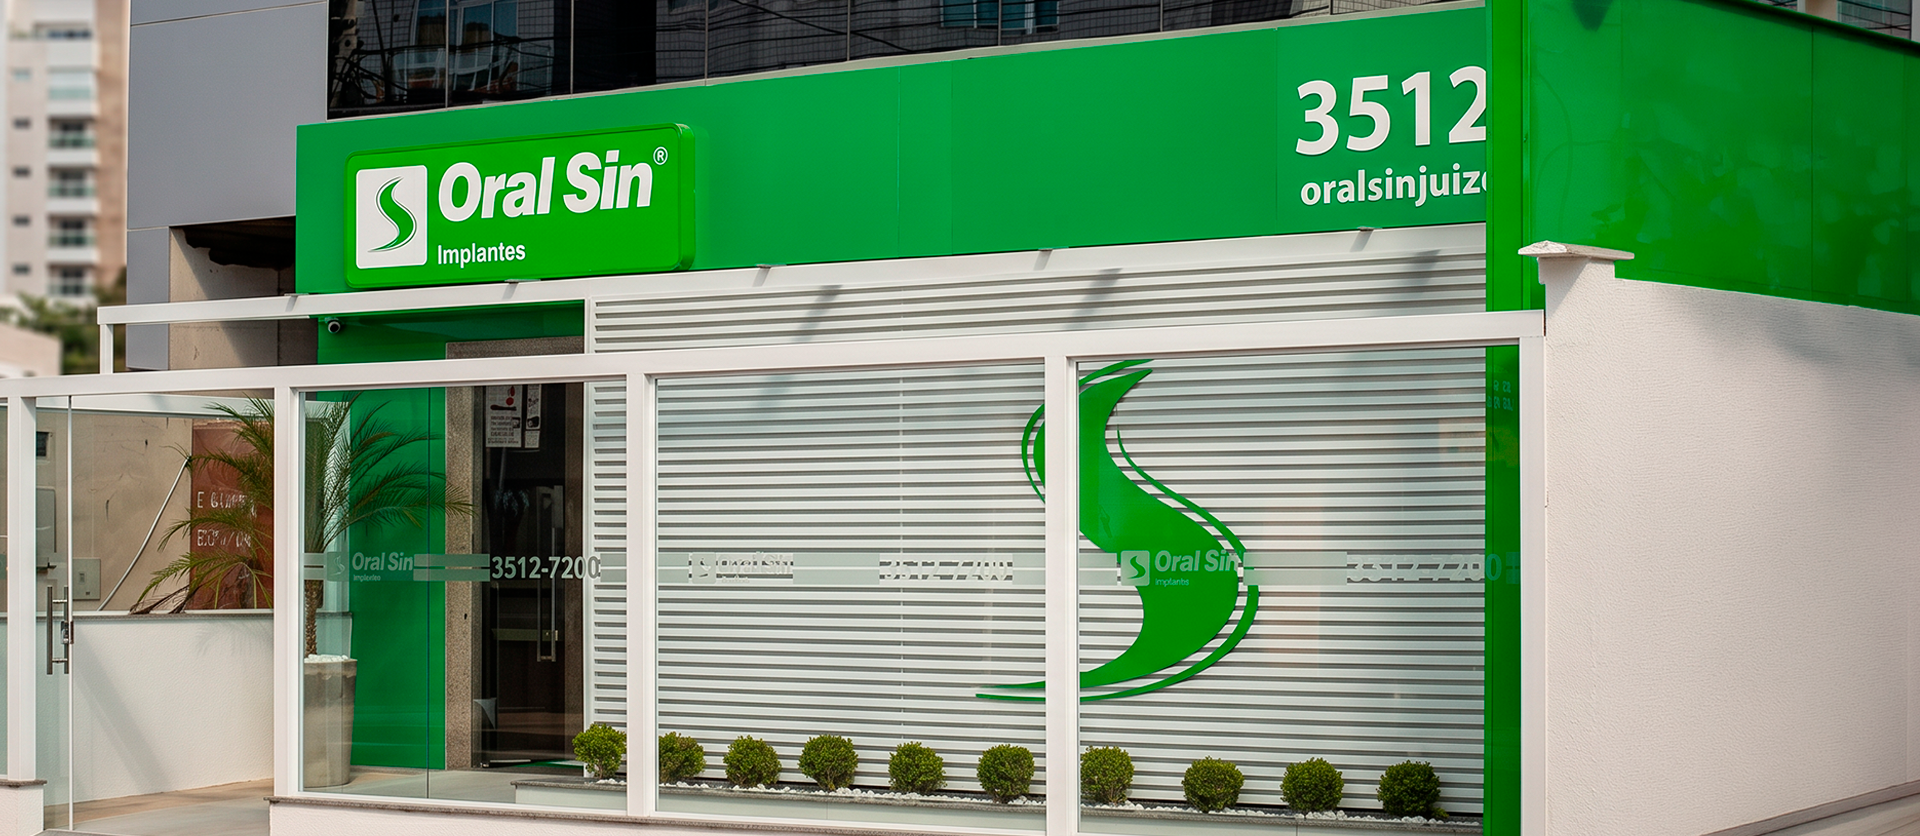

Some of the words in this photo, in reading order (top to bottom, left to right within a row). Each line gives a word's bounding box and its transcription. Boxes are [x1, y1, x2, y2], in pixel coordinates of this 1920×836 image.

[1296, 65, 1486, 156] 3512
[438, 156, 555, 222] Oral
[1300, 162, 1486, 207] oralsinjuiz
[437, 242, 526, 268] Implantes
[352, 551, 386, 571] Oral
[387, 551, 414, 571] Sin
[492, 556, 600, 579] 3512-7200
[1155, 550, 1201, 572] Oral
[1204, 549, 1240, 573] Sin
